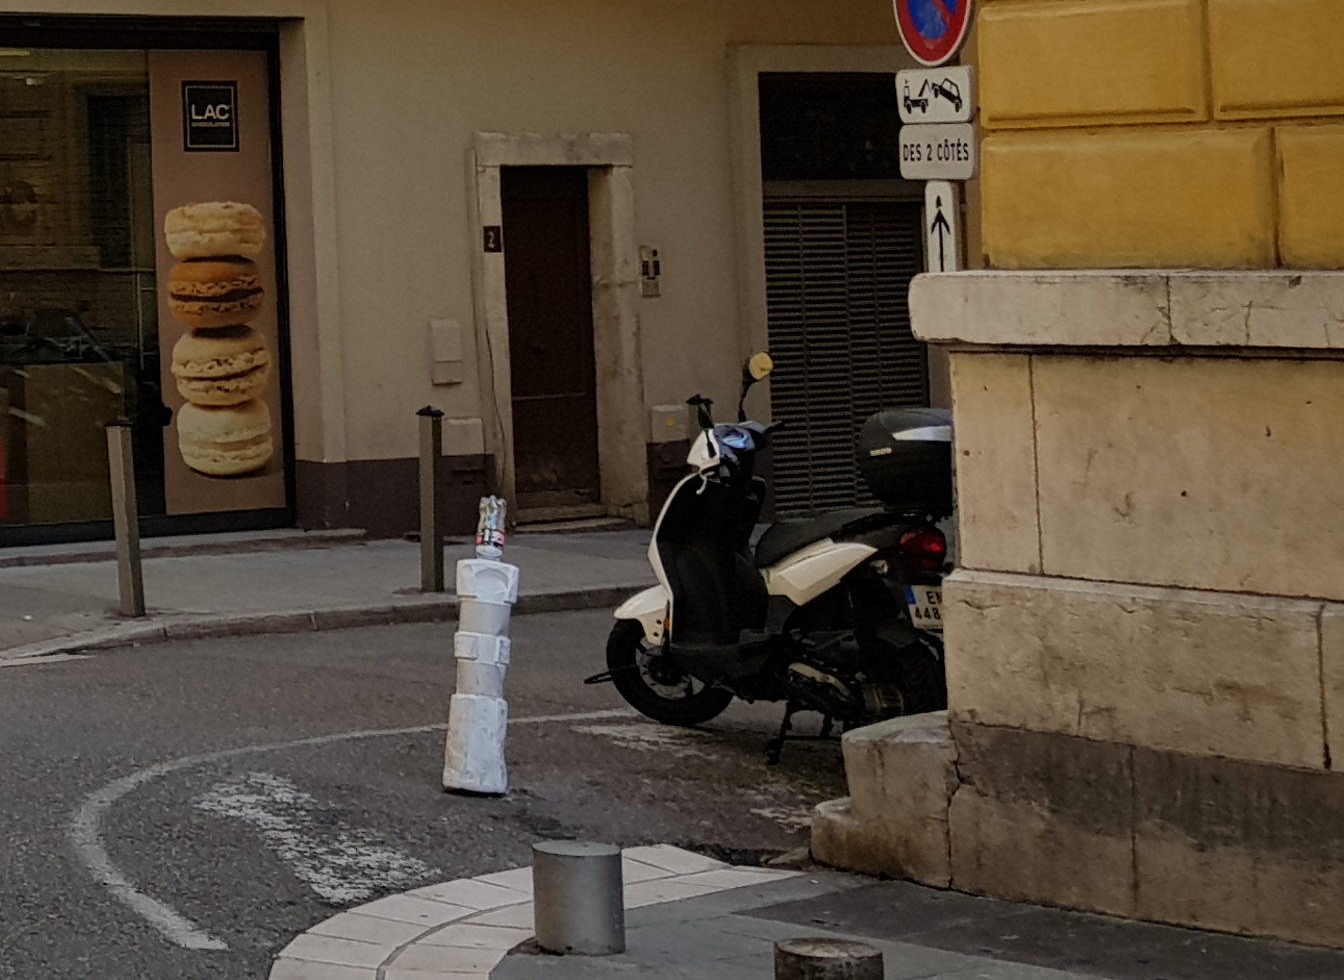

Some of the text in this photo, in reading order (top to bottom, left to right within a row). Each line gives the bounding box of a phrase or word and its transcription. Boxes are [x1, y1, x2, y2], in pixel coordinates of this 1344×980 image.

[191, 104, 230, 119] LAC
[903, 138, 969, 161] DES 2 CÔTÉS
[915, 607, 941, 620] 448
